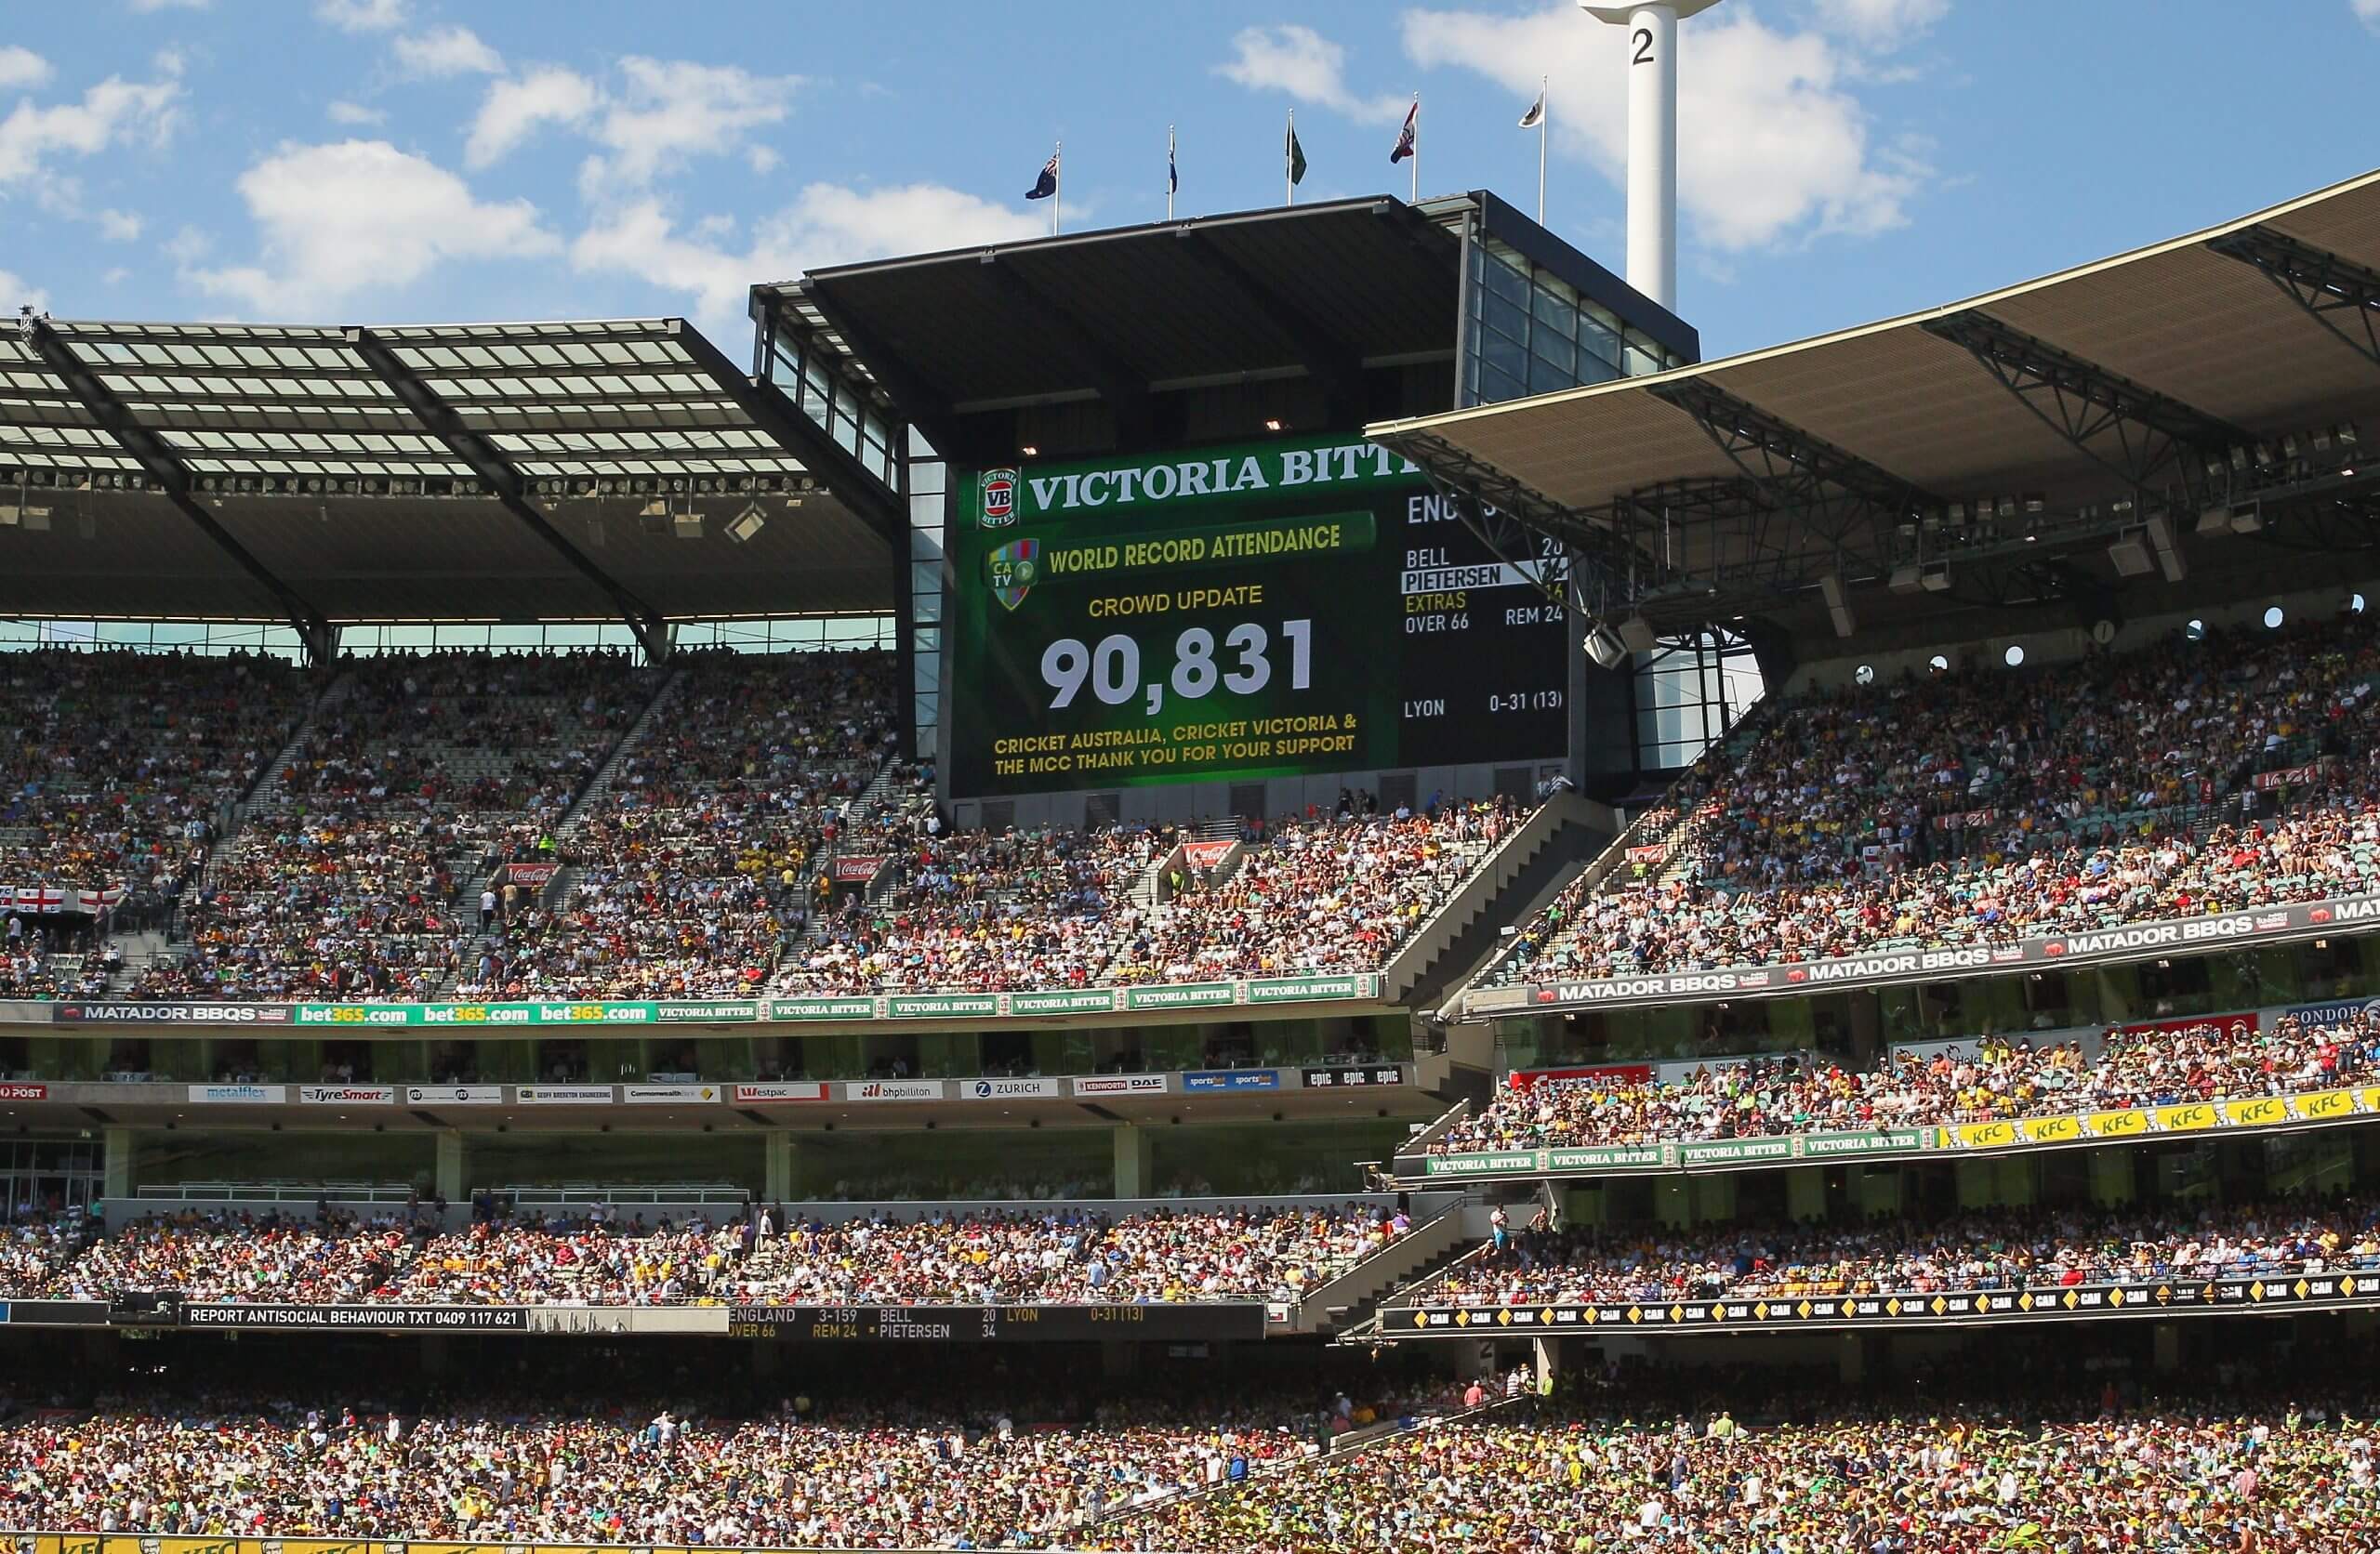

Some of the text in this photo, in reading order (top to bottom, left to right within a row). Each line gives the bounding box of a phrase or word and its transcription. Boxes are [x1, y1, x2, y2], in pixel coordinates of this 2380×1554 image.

[1632, 28, 1655, 66] 2
[981, 471, 1017, 488] VICTORIA
[1028, 455, 1270, 511] VICTORIA
[986, 490, 1011, 507] VB
[982, 511, 1015, 524] BITTER
[1050, 524, 1341, 573] WORLD RECORD ATTENDANCE
[1407, 547, 1450, 568] BELL
[994, 562, 1012, 574] CA
[993, 574, 1012, 586] TV
[1406, 565, 1501, 592] PIETERSEN
[1089, 586, 1263, 618] CROWD UPDATE
[1406, 592, 1466, 612] EXTRAS
[1406, 612, 1469, 633] OVER 66
[1506, 605, 1563, 625] REM 24
[1040, 618, 1312, 717] 90,831
[1405, 691, 1563, 718] LYON 0-31 (13)
[994, 713, 1356, 755] CRICKET AUSTRALIA, CRICKET VICTORIA &
[995, 734, 1355, 775] THE MCC THANK YOU FOR YOUR SUPPORT
[2182, 917, 2253, 941] BBQS
[1922, 948, 1990, 971] BBQS
[1253, 986, 1308, 997] VICTORIA
[1310, 982, 1352, 994] BITTER
[1669, 973, 1737, 994] BBQS
[1016, 998, 1069, 1009] VICTORIA
[1070, 995, 1110, 1007] BITTER
[1135, 993, 1188, 1004] VICTORIA
[1190, 990, 1231, 1001] BITTER
[193, 1007, 256, 1021] BBQS
[424, 1007, 529, 1021] bet365.com
[541, 1006, 646, 1021] bet365.com
[658, 1007, 712, 1018] VICTORIA
[715, 1007, 754, 1017] BITTER
[775, 1006, 830, 1015] VICTORIA
[831, 1004, 871, 1013] BITTER
[895, 1002, 950, 1013] VICTORIA
[952, 1000, 994, 1011] BITTER
[301, 1007, 407, 1022] bet365.com
[1311, 1073, 1331, 1086] epic
[1343, 1072, 1365, 1086] epic
[1377, 1070, 1398, 1085] epic
[12, 1088, 43, 1098] POST
[207, 1086, 266, 1100] metalflex
[741, 1087, 787, 1098] Westpac
[882, 1086, 931, 1099] bhpbilliton
[997, 1083, 1040, 1094] ZURICH
[1086, 1081, 1126, 1091] KENWORTH
[313, 1088, 382, 1101] TyreSmart
[2241, 1100, 2274, 1123] KFC
[2308, 1094, 2341, 1116] KFC
[2102, 1113, 2134, 1134] KFC
[2171, 1106, 2202, 1128] KFC
[1973, 1124, 2003, 1145] KFC
[2036, 1118, 2068, 1140] KFC
[1808, 1138, 1867, 1152] VICTORIA
[1871, 1134, 1916, 1148] BITTER
[1554, 1153, 1609, 1166] VICTORIA
[1613, 1151, 1658, 1164] BITTER
[1686, 1147, 1740, 1160] VICTORIA
[1744, 1143, 1787, 1155] BITTER
[1432, 1160, 1487, 1172] VICTORIA
[1489, 1157, 1531, 1168] BITTER
[191, 1309, 517, 1325] REPORT ANTISOCIAL BEHAVIOUR TXT 0409 117 621
[729, 1309, 857, 1323] ENGLAND 3-159
[880, 1309, 996, 1323] BELL 20
[1007, 1308, 1038, 1322] LYON
[1091, 1308, 1117, 1321] 0-31
[729, 1324, 857, 1337] OVER 66 REM 24
[879, 1324, 996, 1338] PIETERSEN 34
